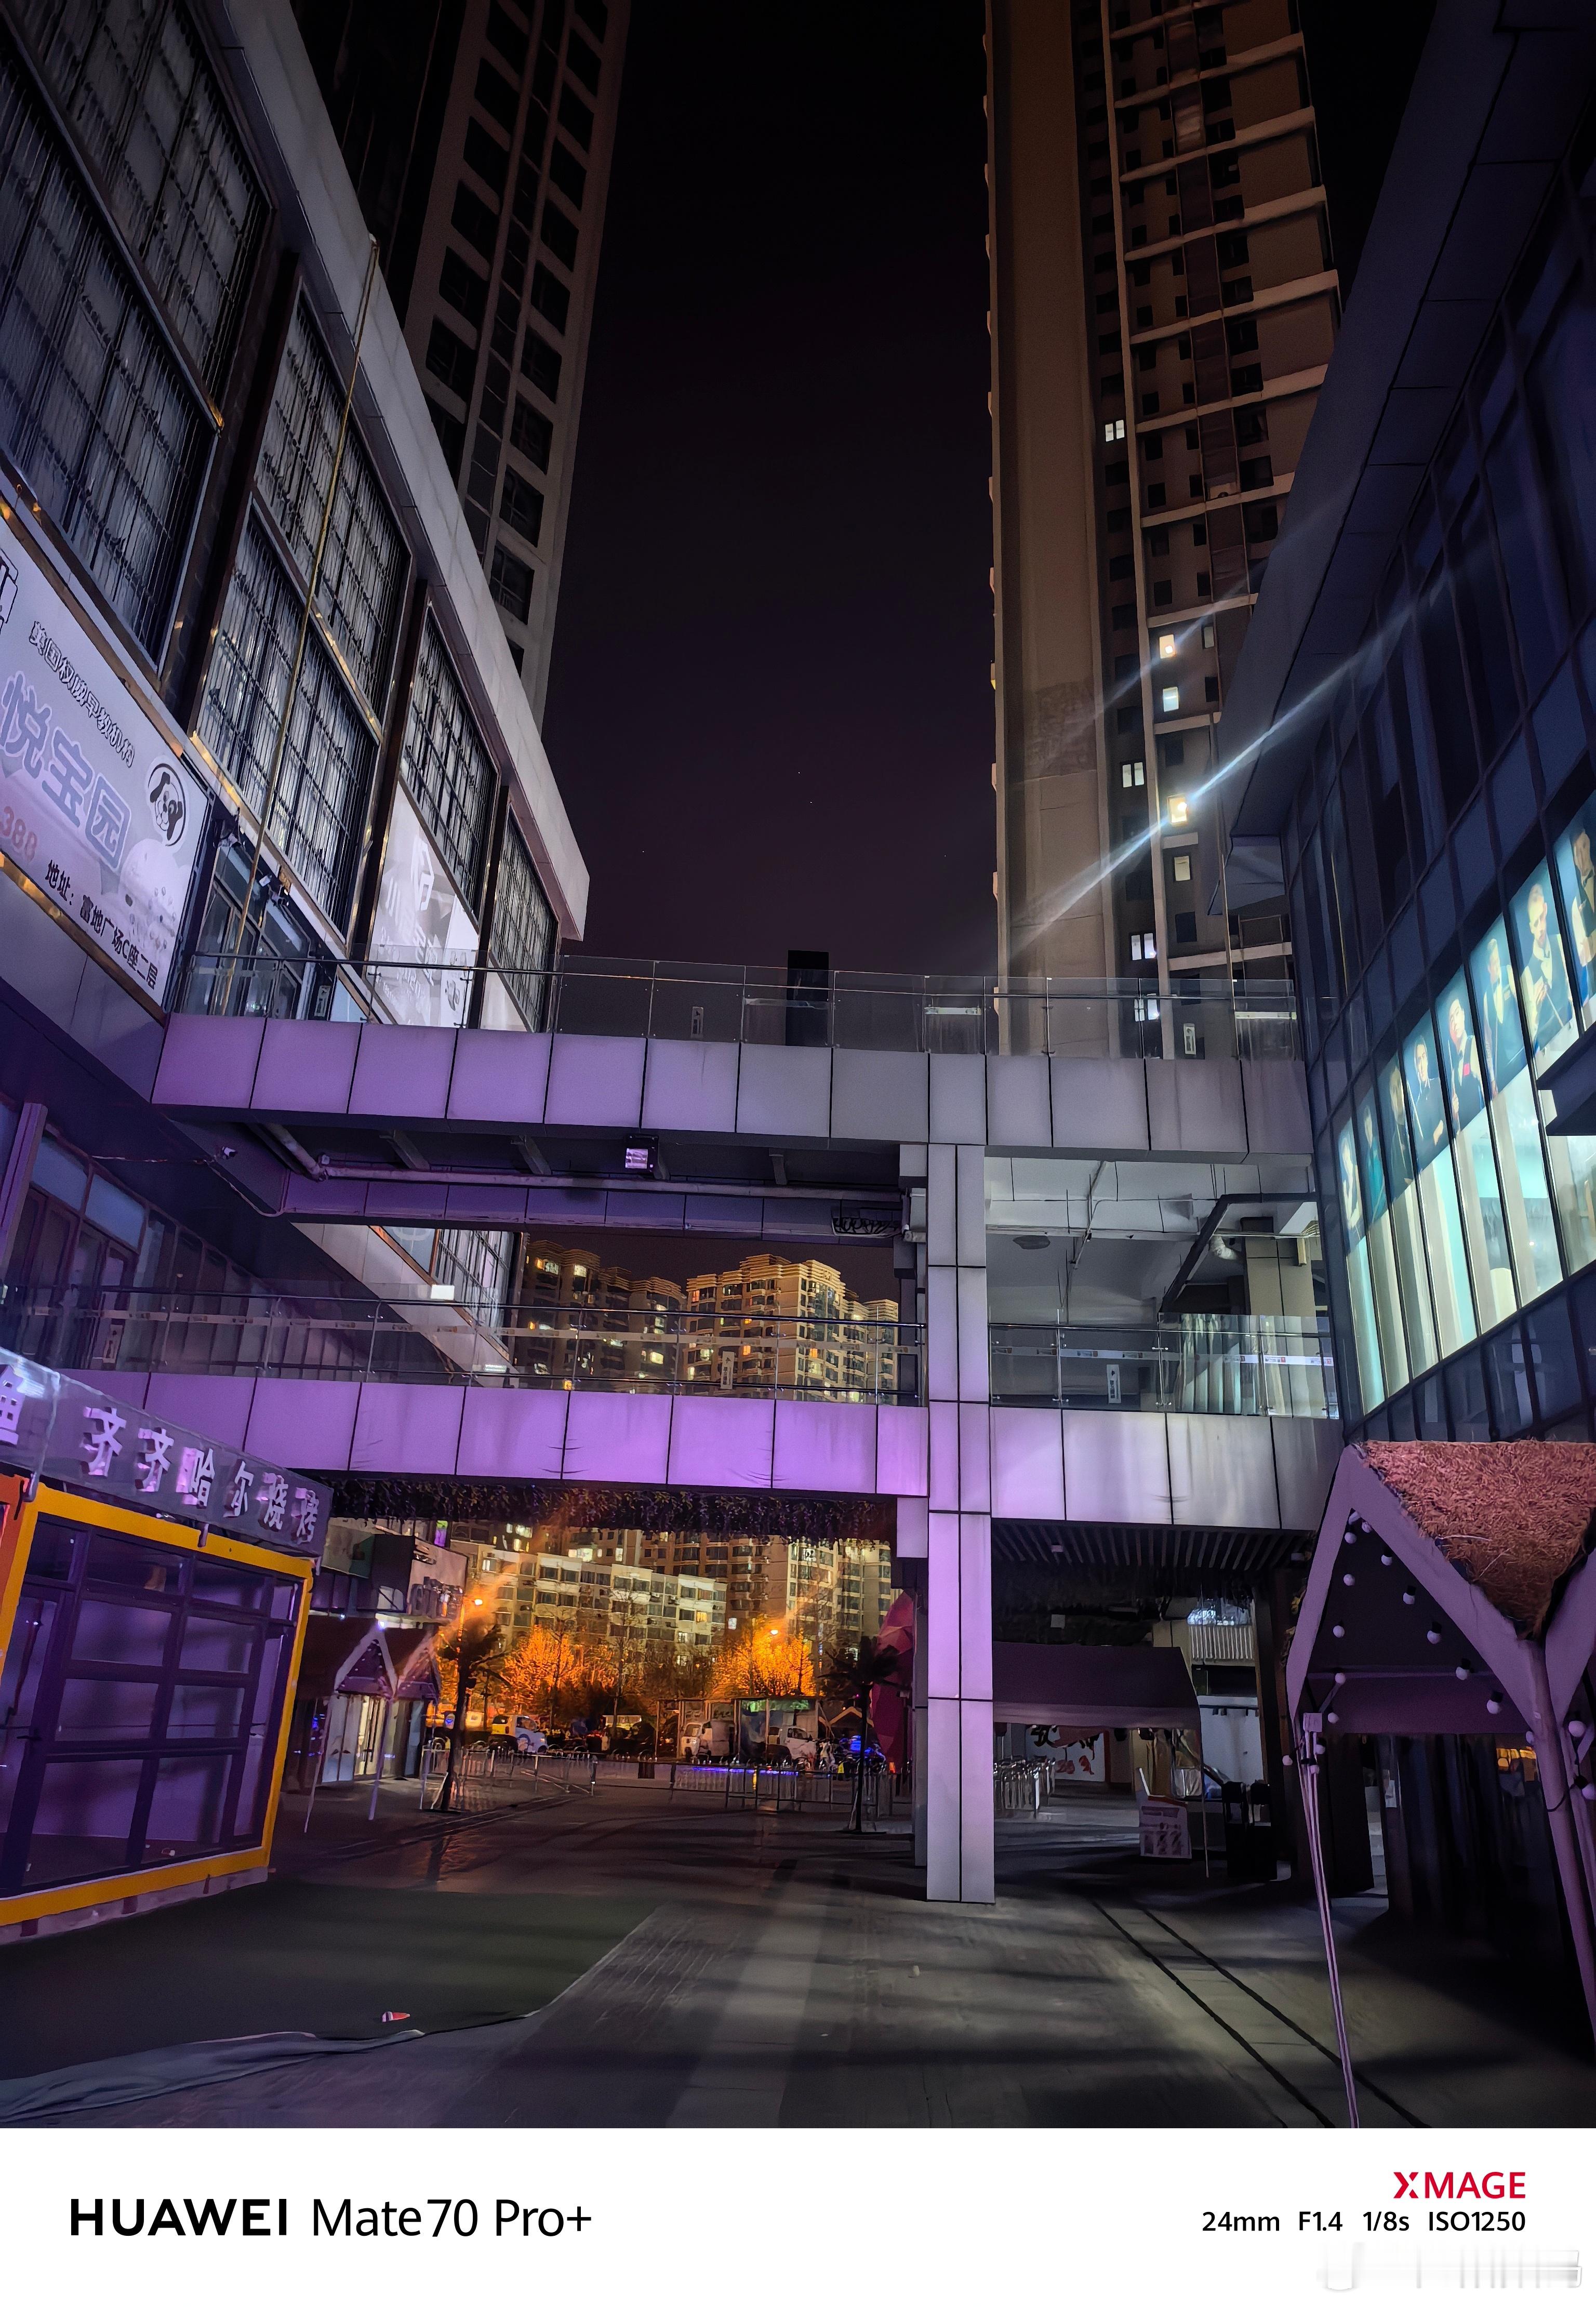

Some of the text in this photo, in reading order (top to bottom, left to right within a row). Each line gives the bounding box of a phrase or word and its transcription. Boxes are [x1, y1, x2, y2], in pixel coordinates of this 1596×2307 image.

[0, 671, 131, 871] 悦宝园
[80, 1406, 320, 1544] 齐齐哈尔烧烤
